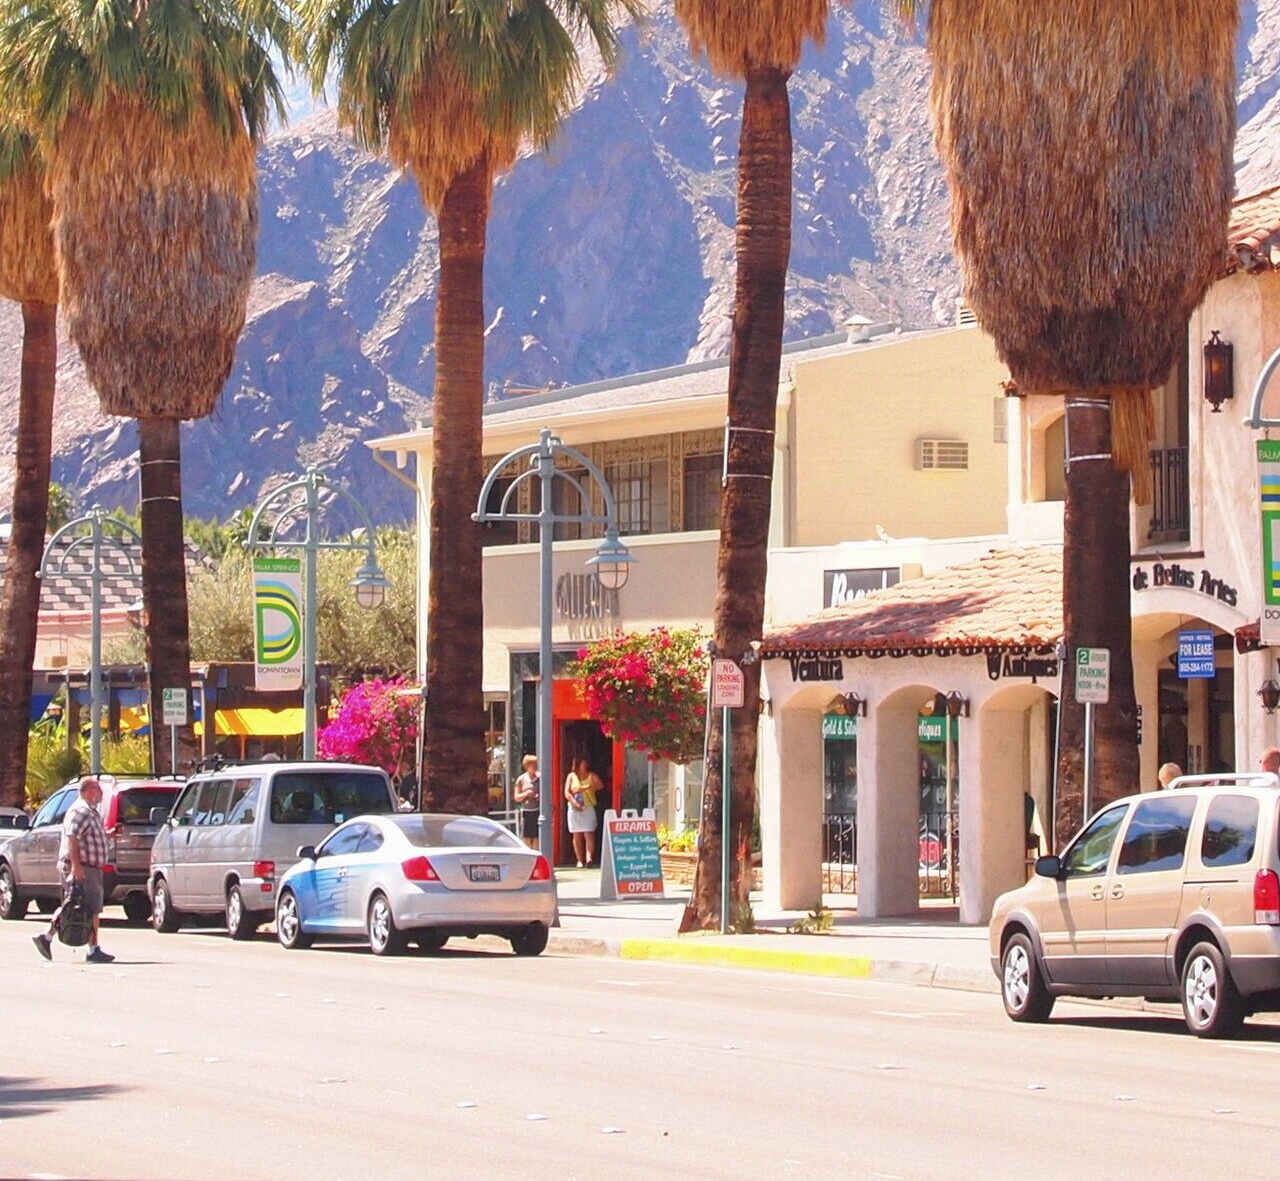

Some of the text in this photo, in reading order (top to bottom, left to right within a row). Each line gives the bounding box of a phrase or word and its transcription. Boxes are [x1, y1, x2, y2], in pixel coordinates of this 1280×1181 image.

[1152, 563, 1195, 589] Bellas
[1198, 569, 1238, 607] Artes
[1180, 643, 1212, 656] FOR LEASE
[1080, 650, 1088, 663] 2
[723, 663, 735, 673] NO
[789, 656, 844, 682] Ventura
[1003, 655, 1058, 684] Antiques
[717, 673, 741, 683] PARKING
[615, 821, 652, 833] BRAMS
[627, 881, 654, 893] OPEN
